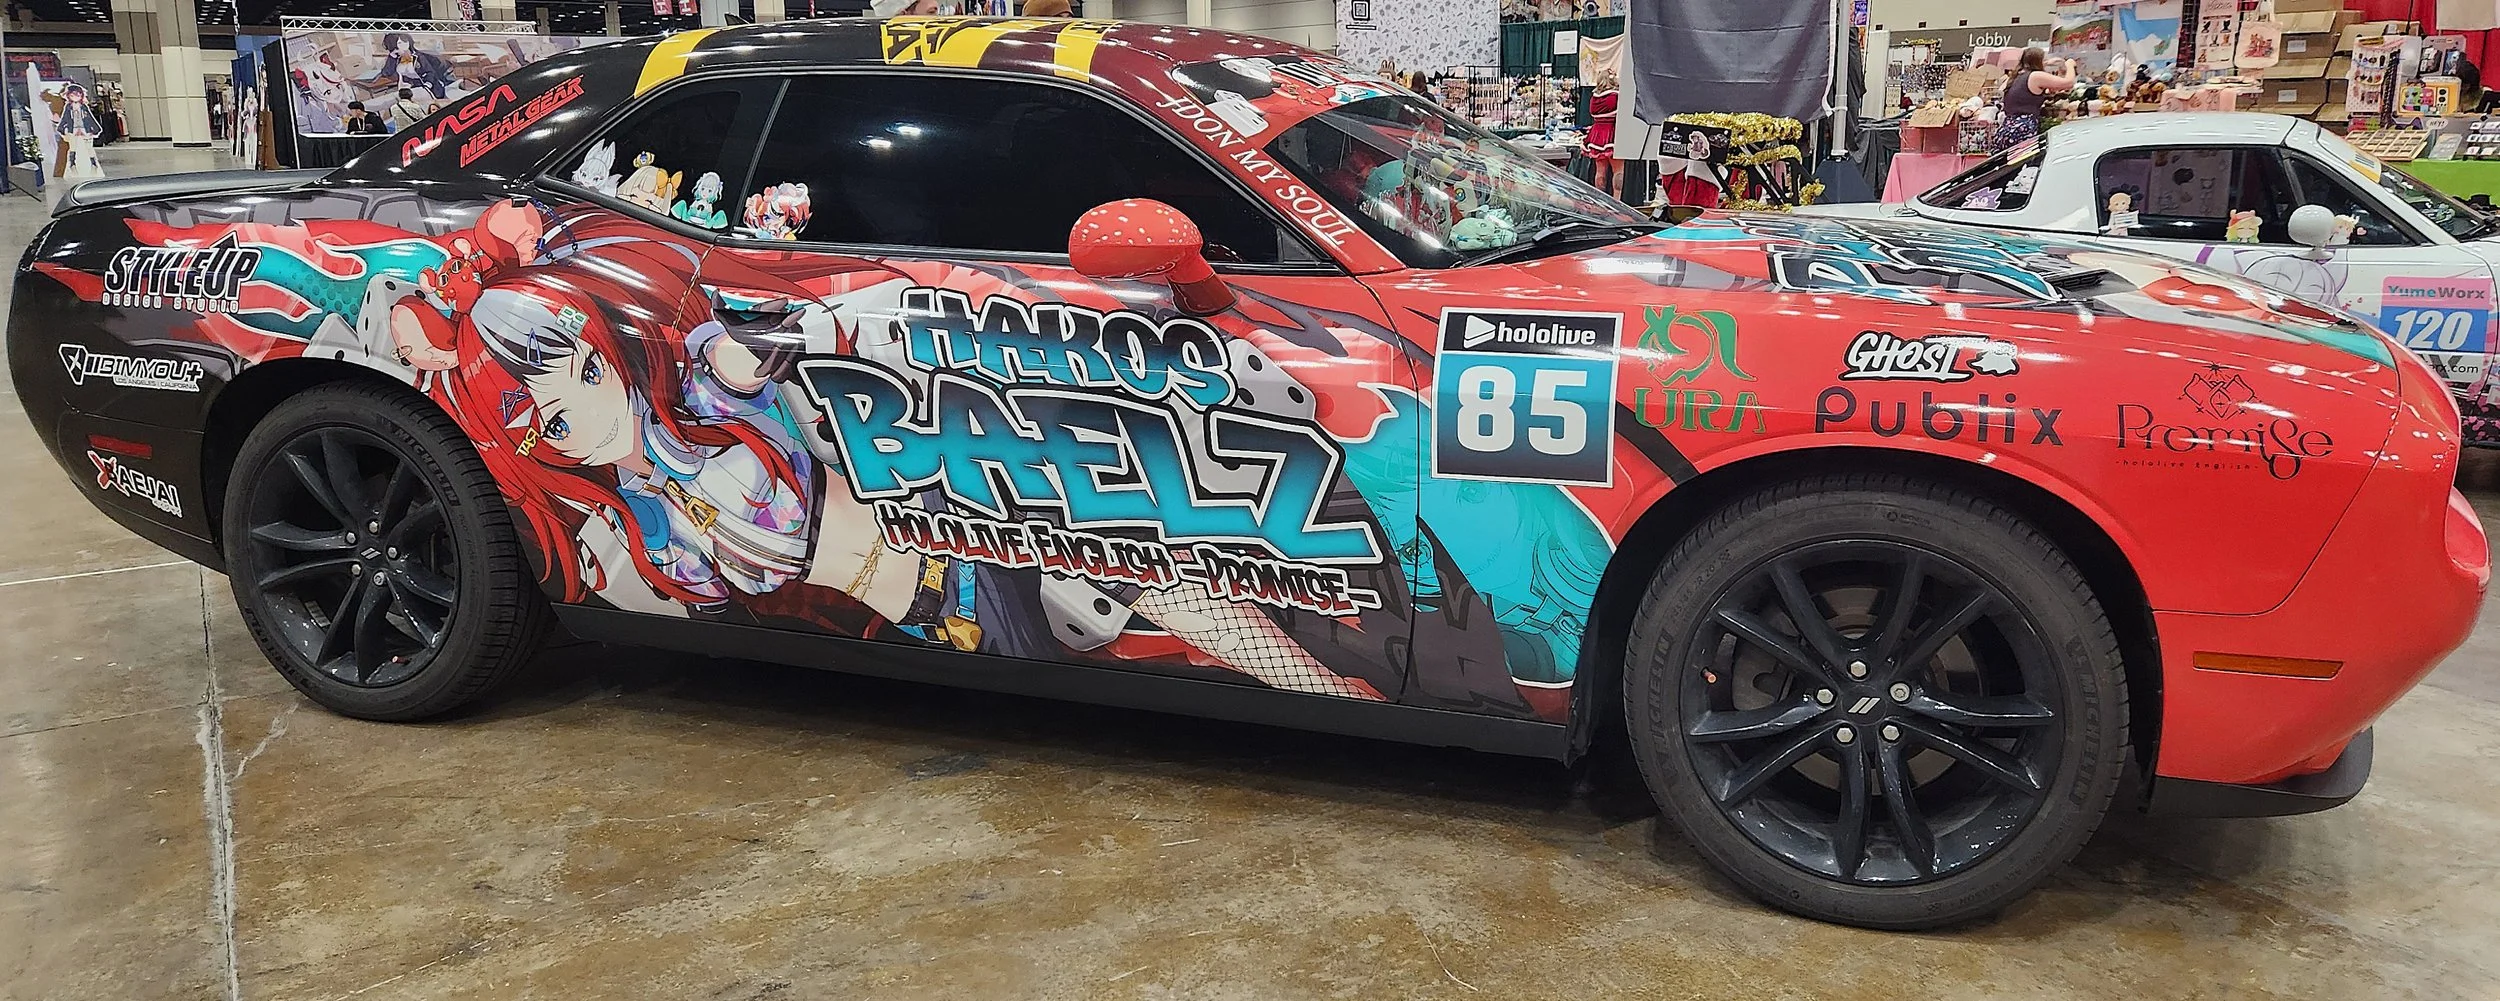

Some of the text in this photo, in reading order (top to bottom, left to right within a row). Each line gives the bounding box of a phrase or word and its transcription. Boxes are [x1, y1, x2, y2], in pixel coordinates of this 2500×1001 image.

[1968, 31, 2012, 47] Lobby
[402, 84, 517, 168] NASA
[460, 74, 585, 169] METAL GEAR
[1230, 148, 1292, 184] MY
[1275, 184, 1357, 247] SOUL
[105, 233, 262, 300] STYLEUP
[2387, 285, 2485, 299] YumeWorx
[102, 293, 239, 313] DESIGN STUDIO
[2395, 310, 2473, 350] 120
[898, 288, 1237, 411] HAKOS
[1497, 322, 1596, 346] hololive
[1842, 331, 1989, 381] GHOST
[115, 377, 129, 385] LOS
[1457, 365, 1587, 456] 85
[1634, 387, 1766, 433] URA
[1815, 385, 2063, 446] Publix
[799, 357, 1386, 564] BAELZ
[876, 500, 1035, 566] HOLOLIVE
[1031, 521, 1179, 589] ENGLISH
